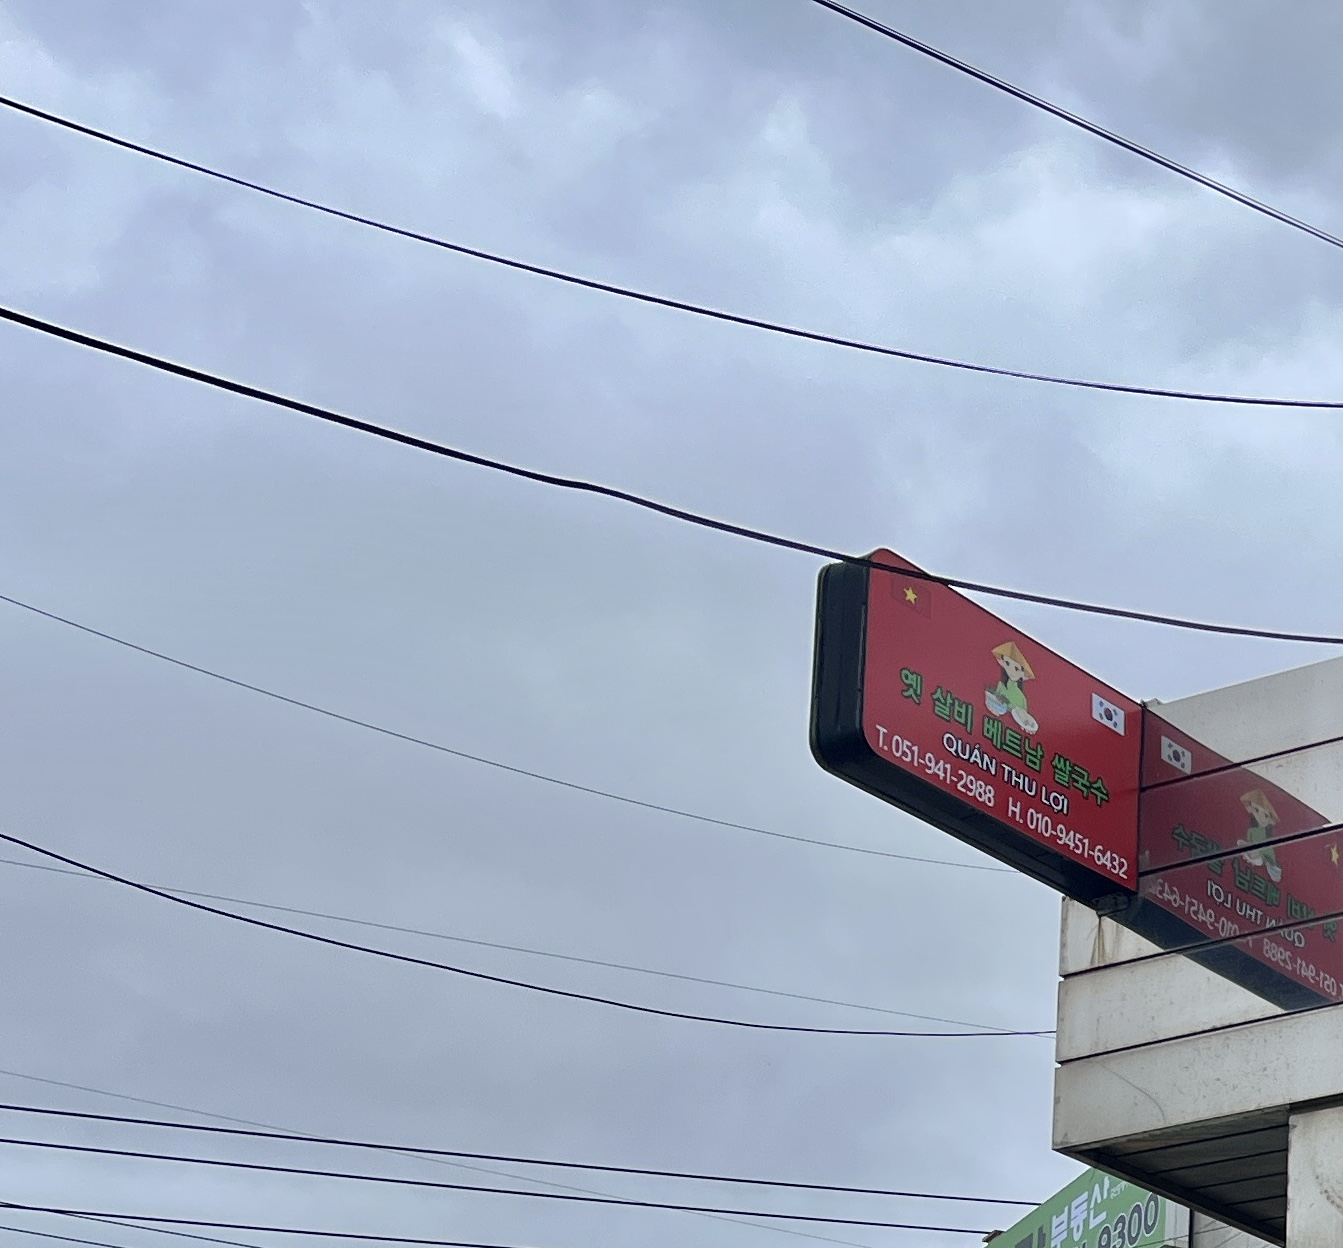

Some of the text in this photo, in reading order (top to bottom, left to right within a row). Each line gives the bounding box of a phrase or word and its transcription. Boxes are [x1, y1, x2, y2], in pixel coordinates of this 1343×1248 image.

[876, 724, 1129, 880] T. 051-941-2988 H. 010-9451-6432
[901, 667, 1110, 807] 옛 살비 베트남 쌀국수
[942, 732, 1069, 815] QUÁN THU LỢI
